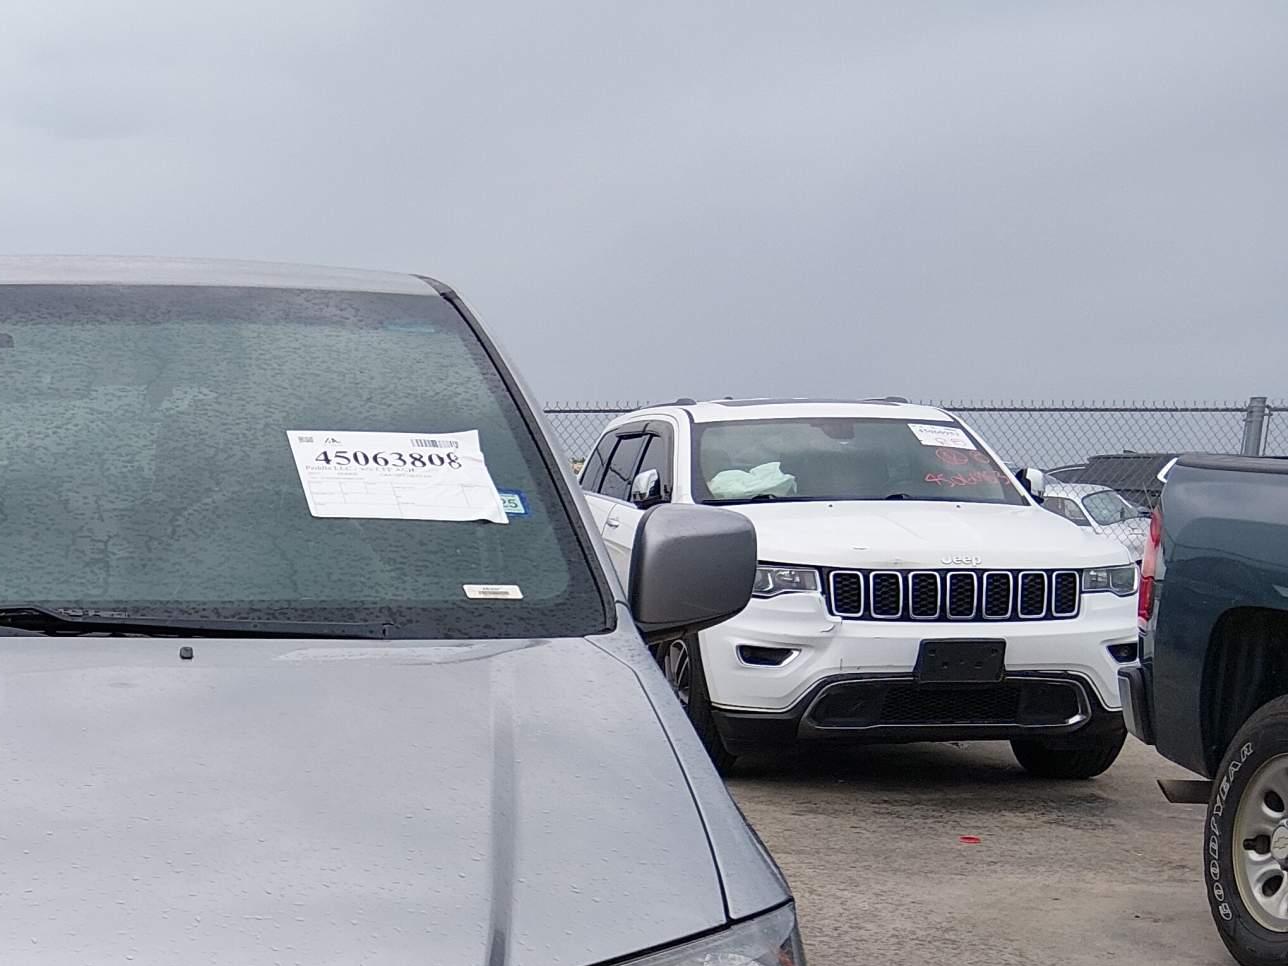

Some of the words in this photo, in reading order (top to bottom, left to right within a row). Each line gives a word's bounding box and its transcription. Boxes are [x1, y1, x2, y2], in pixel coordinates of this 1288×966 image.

[315, 450, 462, 470] 45063808
[942, 552, 982, 567] Jeep
[1209, 742, 1253, 921] GOODYEAR
